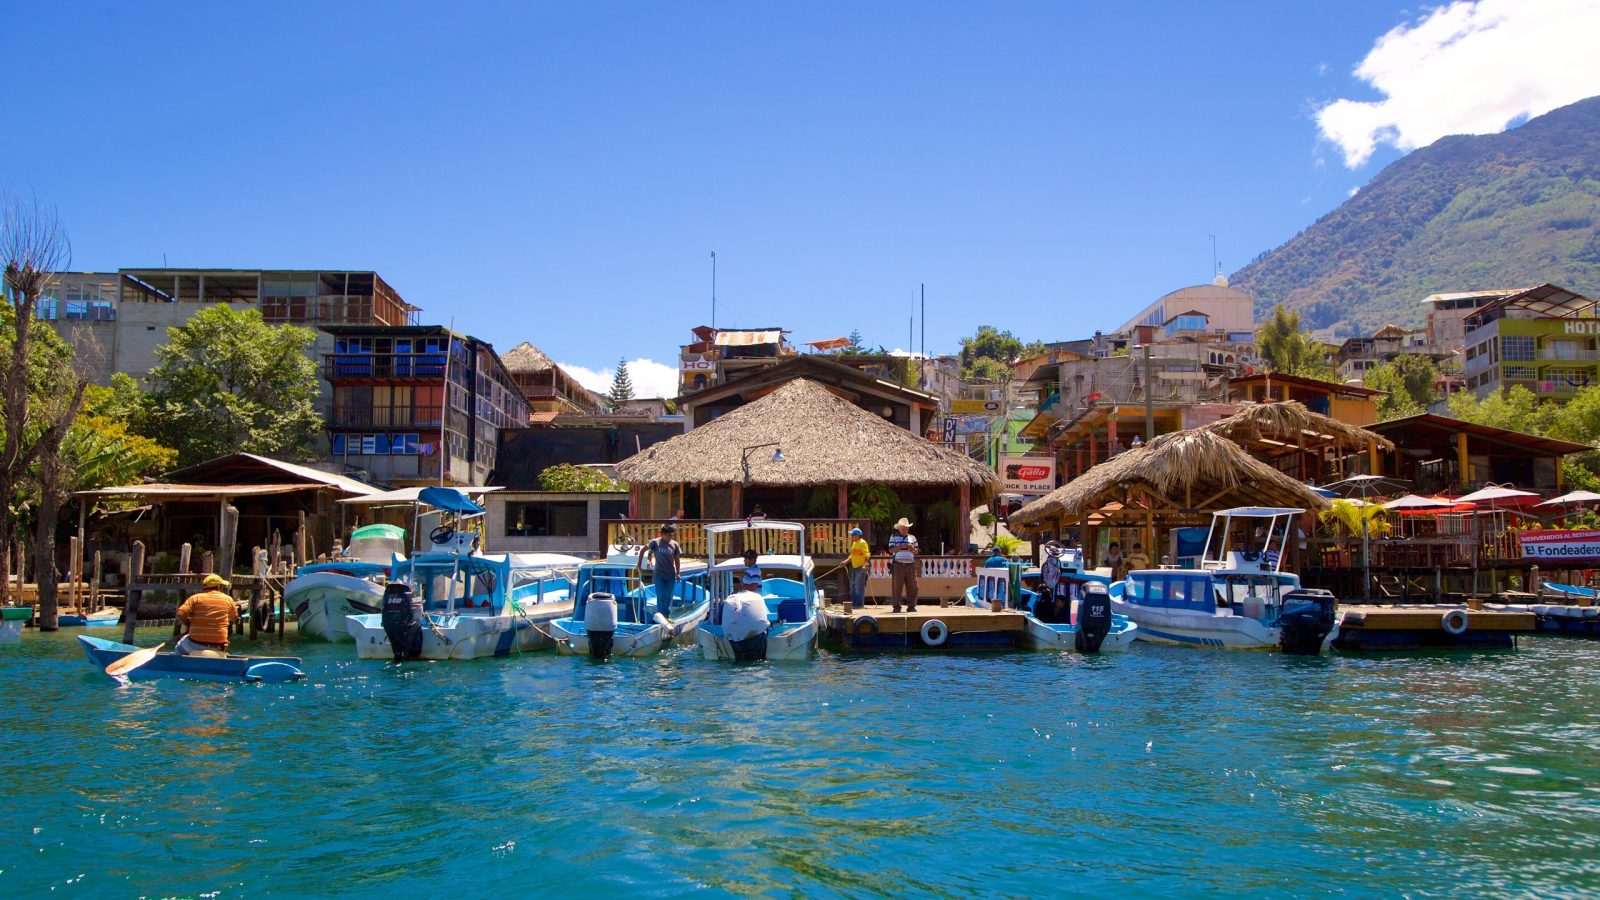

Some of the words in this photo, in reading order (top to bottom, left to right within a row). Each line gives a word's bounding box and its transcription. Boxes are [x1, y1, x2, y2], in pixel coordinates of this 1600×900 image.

[1018, 467, 1046, 477] Gallo
[1525, 545, 1535, 555] El
[1538, 544, 1600, 556] Fondeadero
